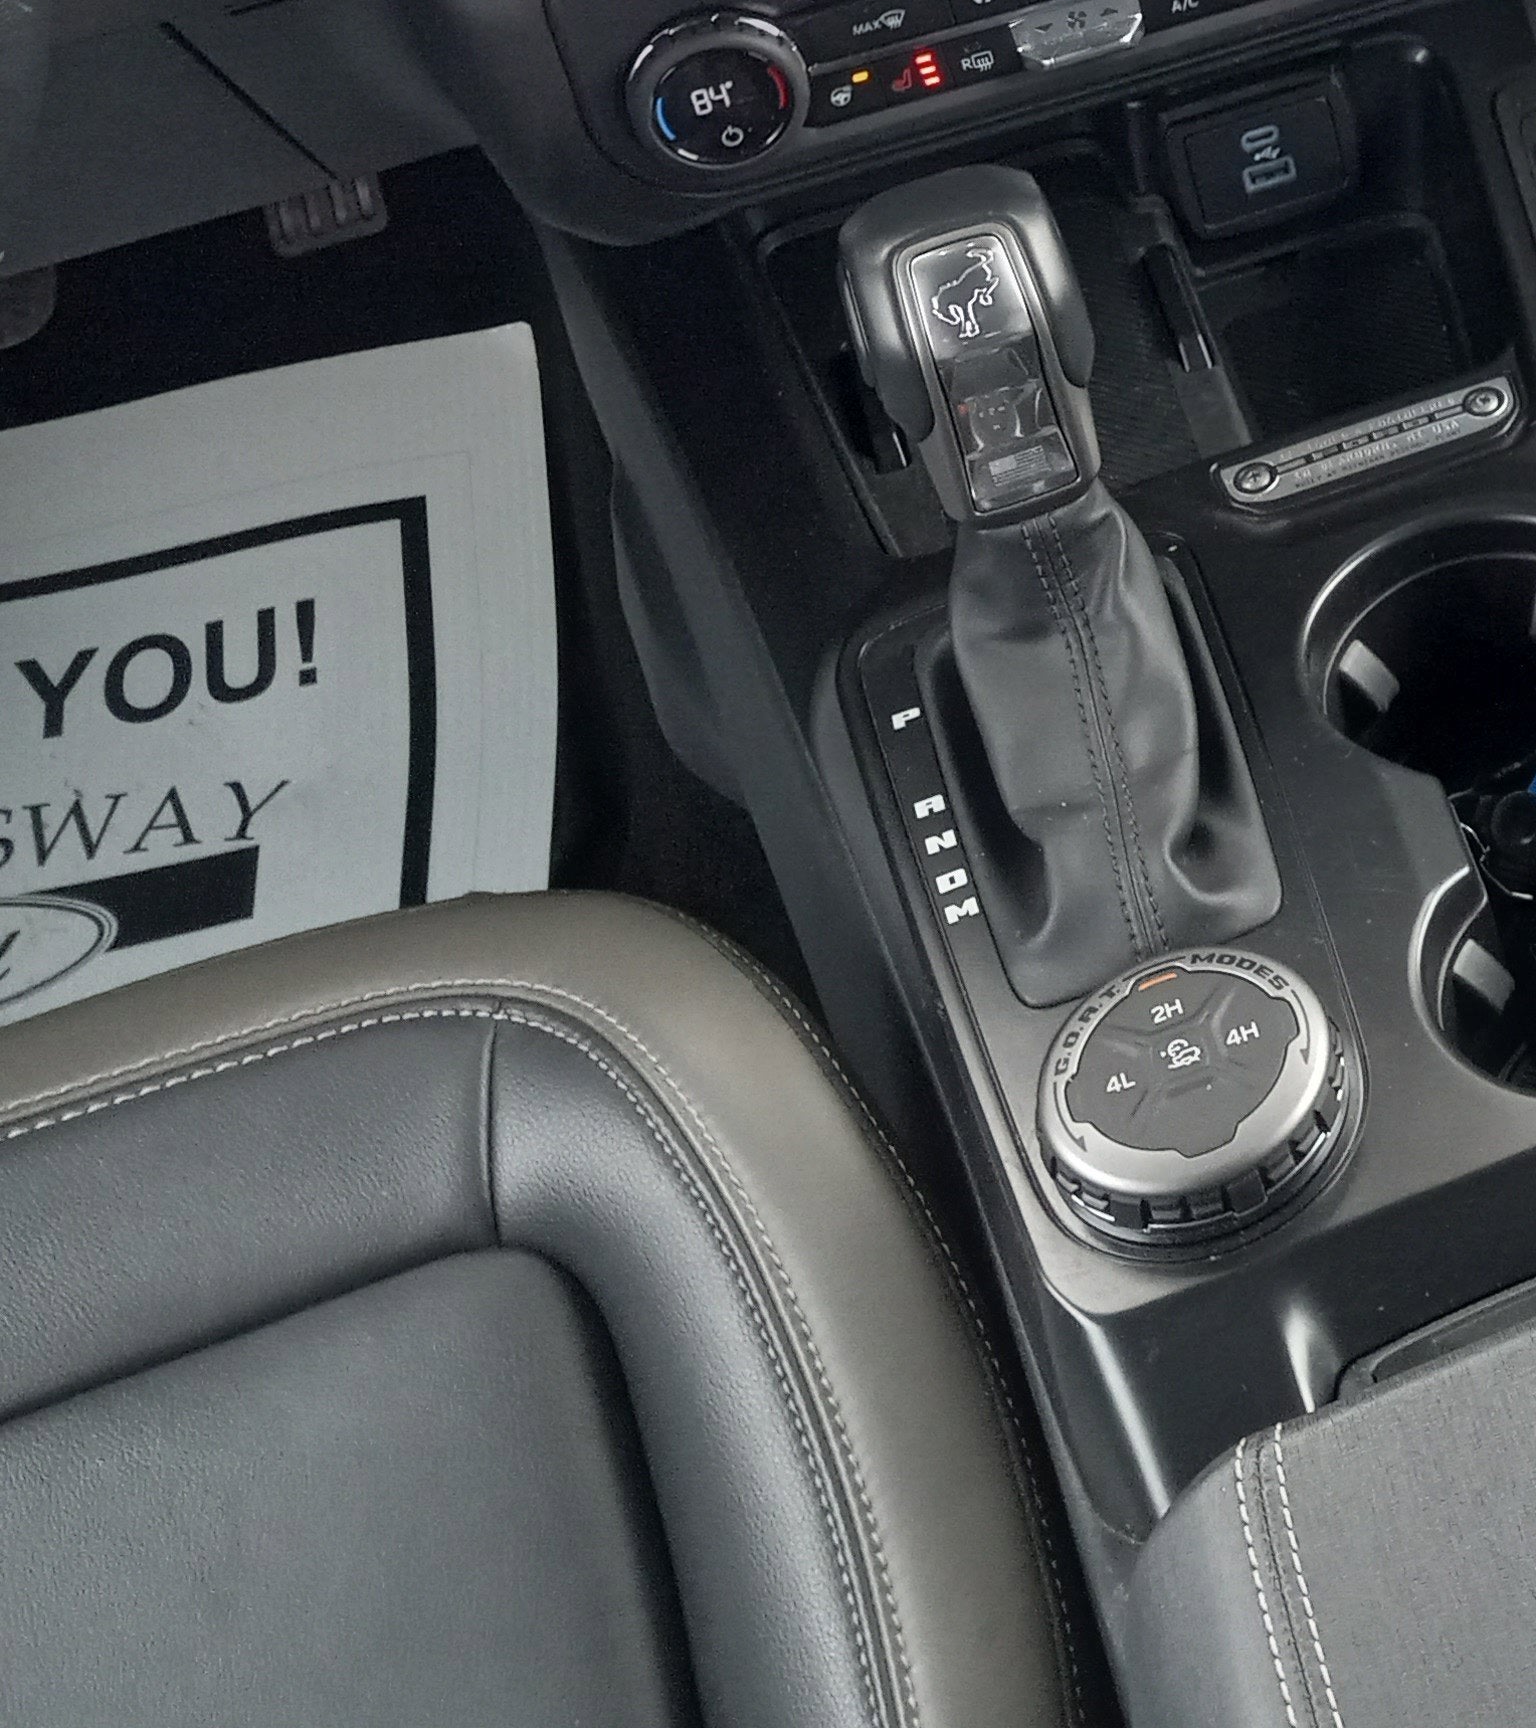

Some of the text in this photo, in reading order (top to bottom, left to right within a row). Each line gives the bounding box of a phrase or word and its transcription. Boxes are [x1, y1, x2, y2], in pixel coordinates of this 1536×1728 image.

[852, 19, 882, 36] MAX
[13, 597, 319, 739] YOU!
[891, 706, 921, 731] P
[924, 828, 958, 855] N
[943, 896, 980, 925] M
[1190, 952, 1290, 992] MODES
[1150, 998, 1185, 1024] 2H
[1225, 1021, 1260, 1047] 4H
[1105, 1072, 1137, 1094] 4L
